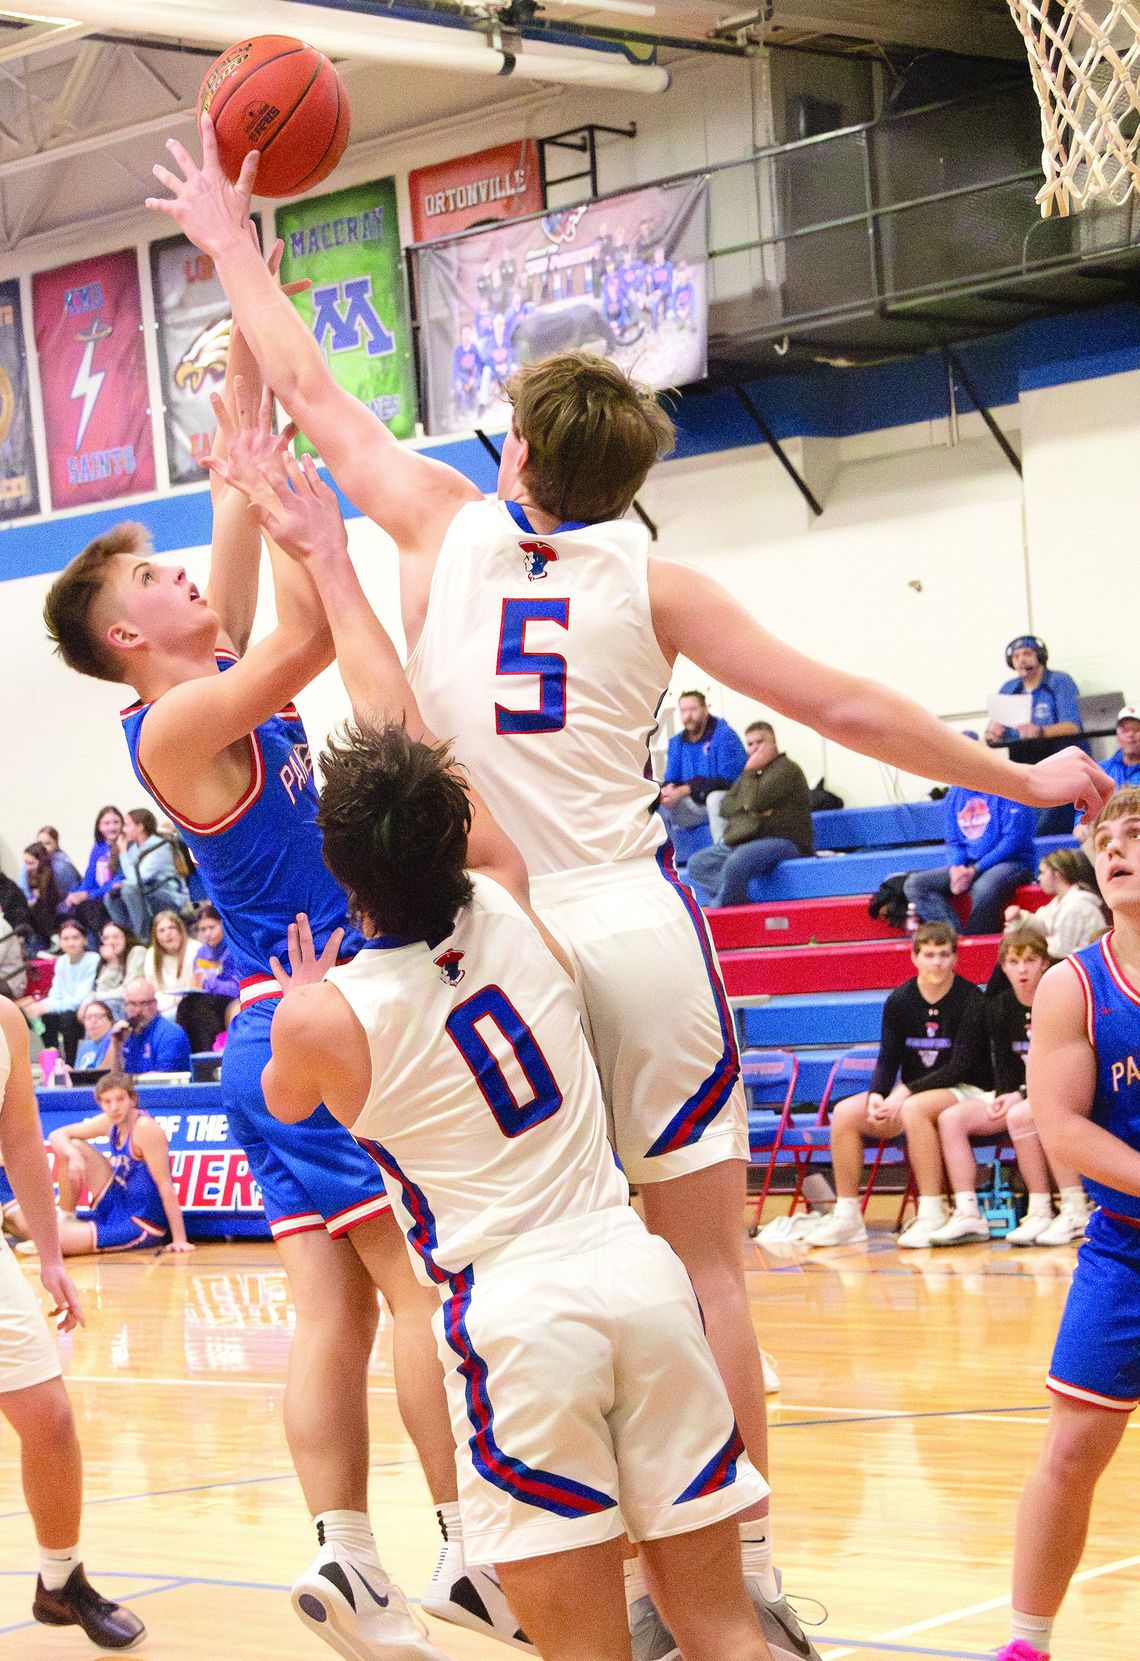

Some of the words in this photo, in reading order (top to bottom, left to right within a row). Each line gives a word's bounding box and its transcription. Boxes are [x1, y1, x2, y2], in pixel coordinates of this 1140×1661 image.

[424, 169, 527, 216] ORTONVILLE
[494, 597, 571, 735] 5
[445, 983, 563, 1139] 0
[186, 1114, 229, 1142] THE
